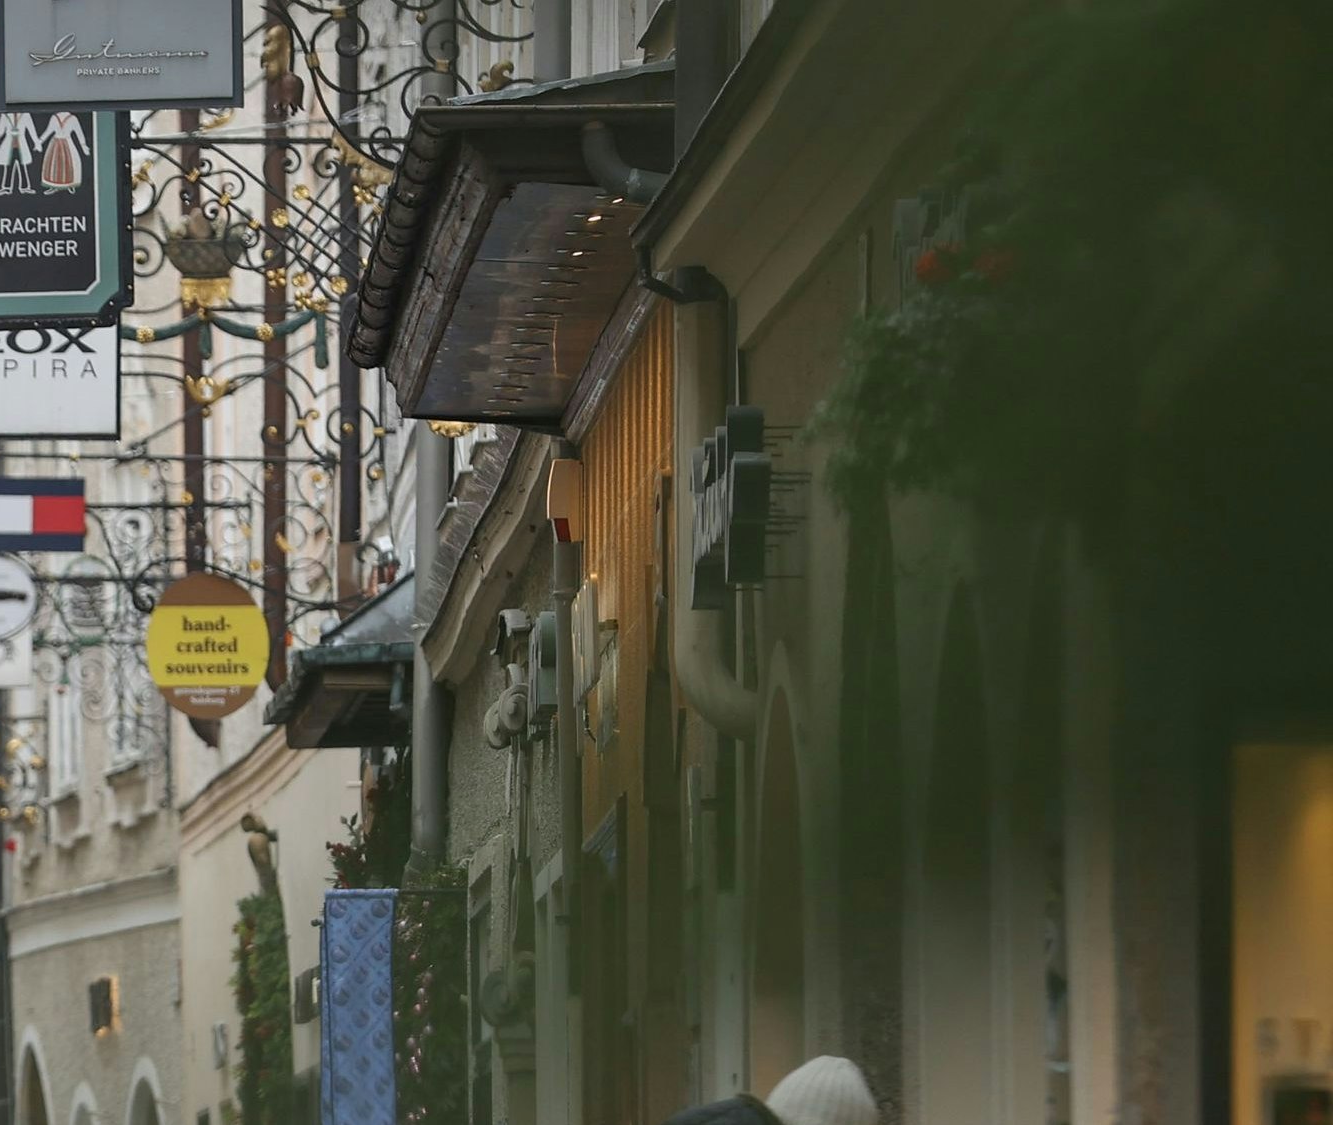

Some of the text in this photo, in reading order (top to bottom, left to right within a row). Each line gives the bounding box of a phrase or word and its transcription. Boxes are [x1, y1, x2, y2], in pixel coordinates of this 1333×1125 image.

[76, 66, 160, 76] PRIVATE BANKERS
[182, 615, 231, 632] hand-
[176, 636, 238, 652] crafted
[165, 659, 249, 674] souvenirs
